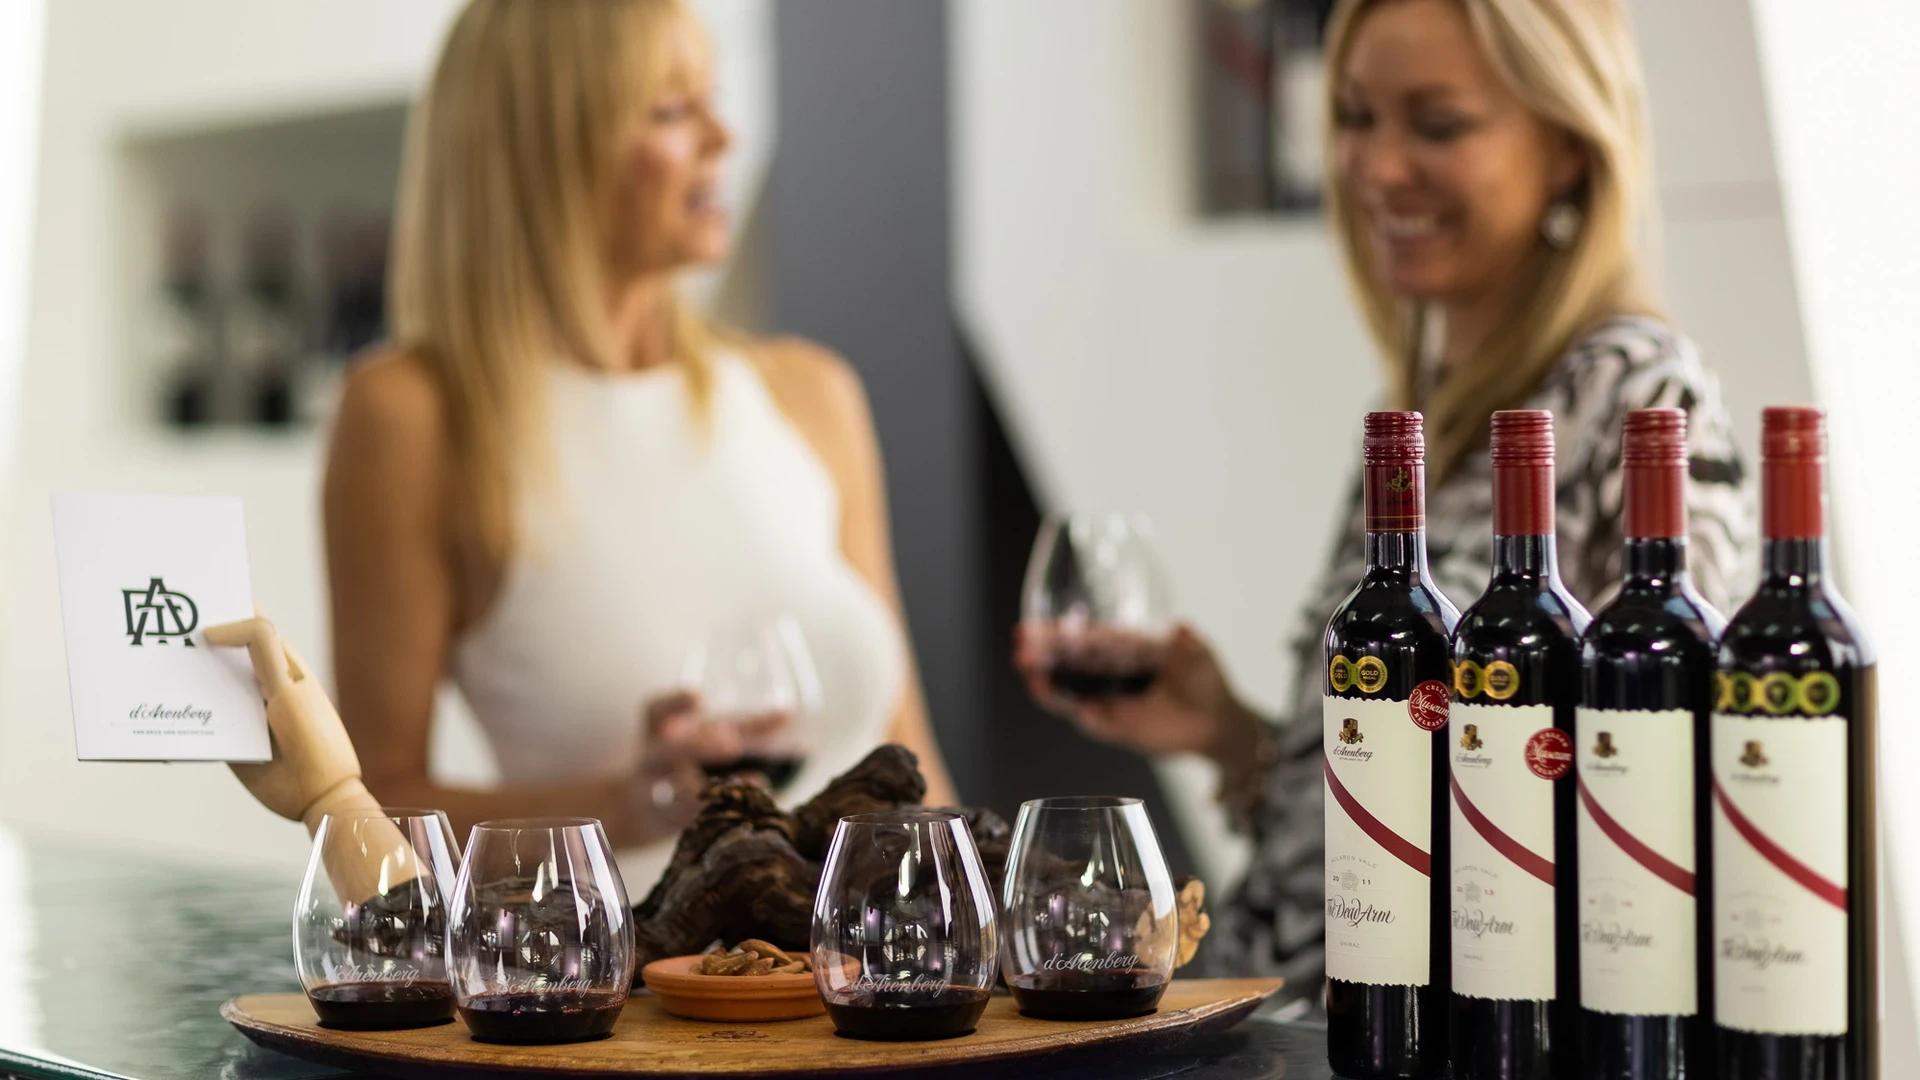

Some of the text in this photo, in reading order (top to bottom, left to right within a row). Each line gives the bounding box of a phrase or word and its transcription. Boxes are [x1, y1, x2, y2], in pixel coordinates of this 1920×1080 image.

[1360, 668, 1379, 677] GOLD
[1411, 689, 1450, 717] Museum
[1425, 684, 1449, 704] CELLAR
[1414, 712, 1444, 728] RELEASE
[1359, 859, 1378, 870] VALE
[1333, 893, 1362, 921] Dead
[1347, 903, 1396, 928] Arm
[1043, 950, 1139, 974] d'Arenberg
[851, 973, 947, 998] d'Arenberg
